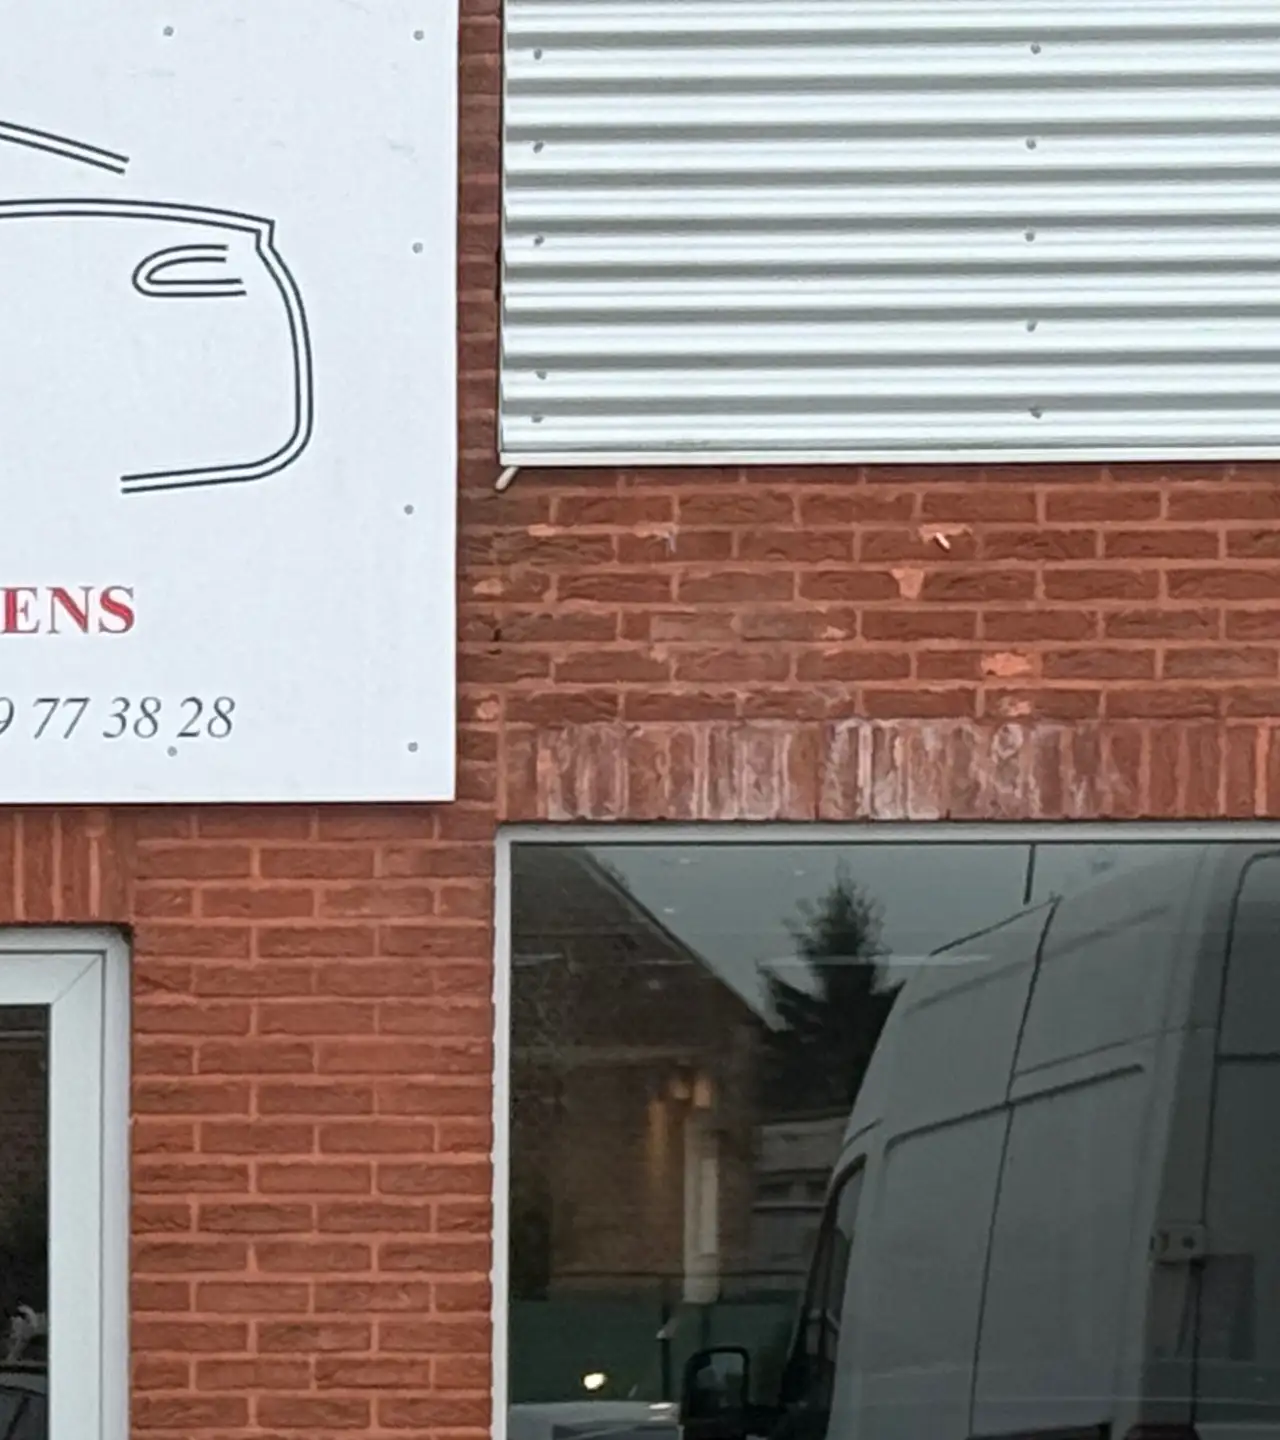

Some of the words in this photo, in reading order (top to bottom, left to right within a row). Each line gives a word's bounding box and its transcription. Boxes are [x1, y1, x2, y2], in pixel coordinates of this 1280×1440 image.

[34, 696, 90, 741] 77
[102, 696, 162, 741] 38
[177, 696, 237, 741] 28
